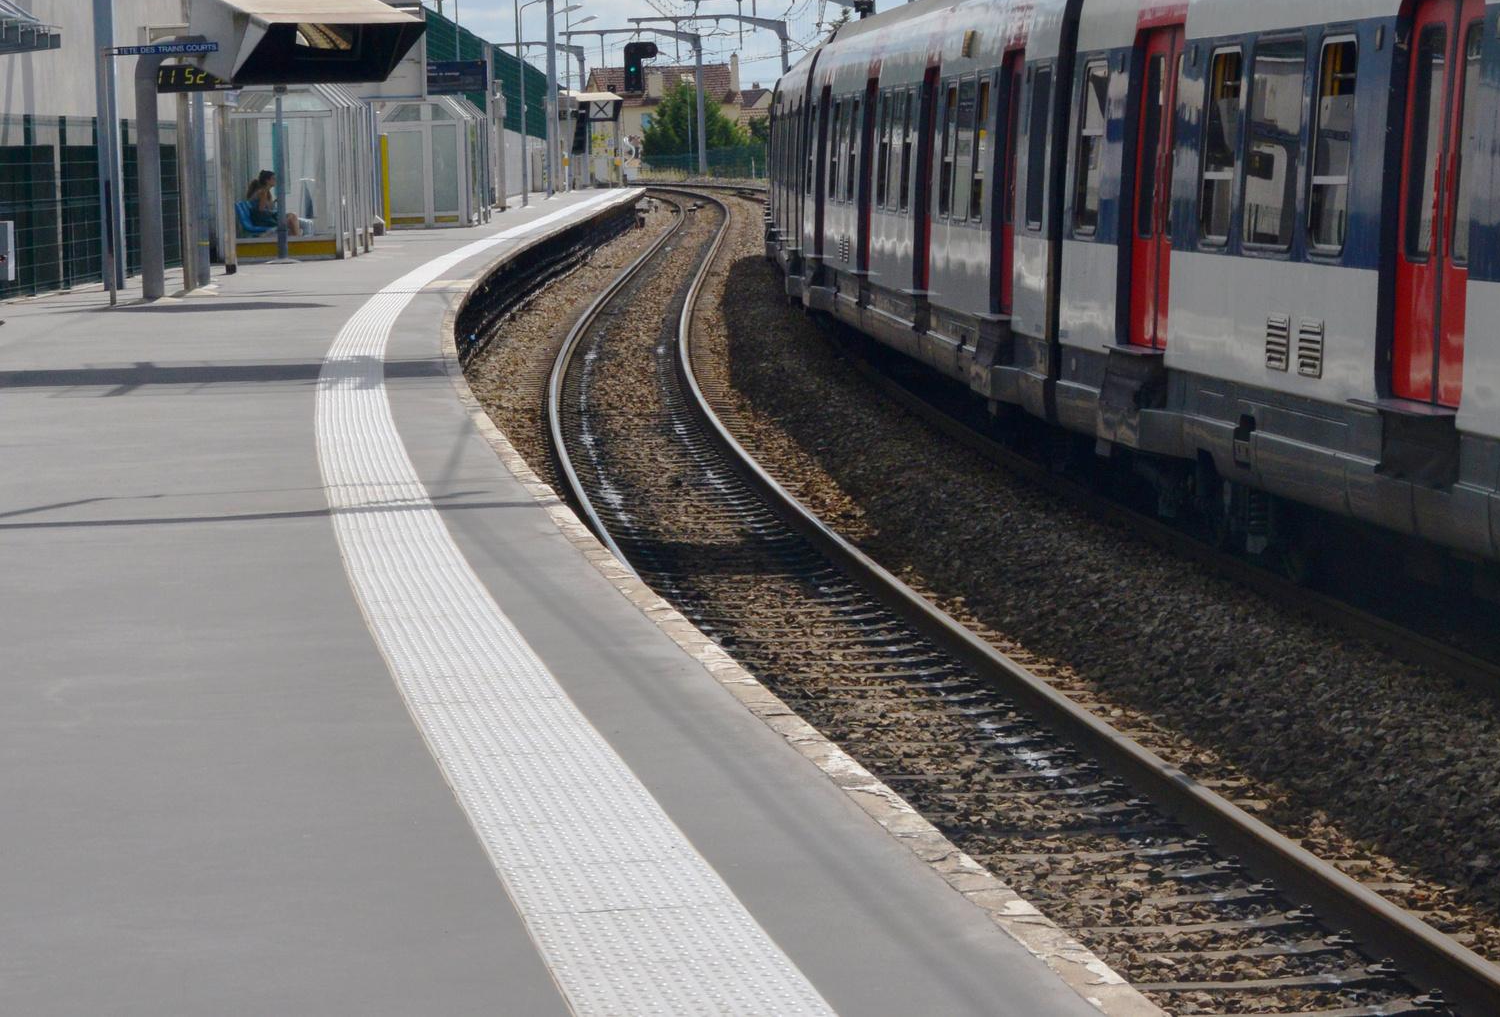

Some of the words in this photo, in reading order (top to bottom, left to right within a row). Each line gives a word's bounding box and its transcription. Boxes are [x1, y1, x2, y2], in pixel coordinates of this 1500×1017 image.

[158, 45, 184, 53] TRAINS
[186, 43, 217, 52] COURTS
[184, 68, 207, 84] 52
